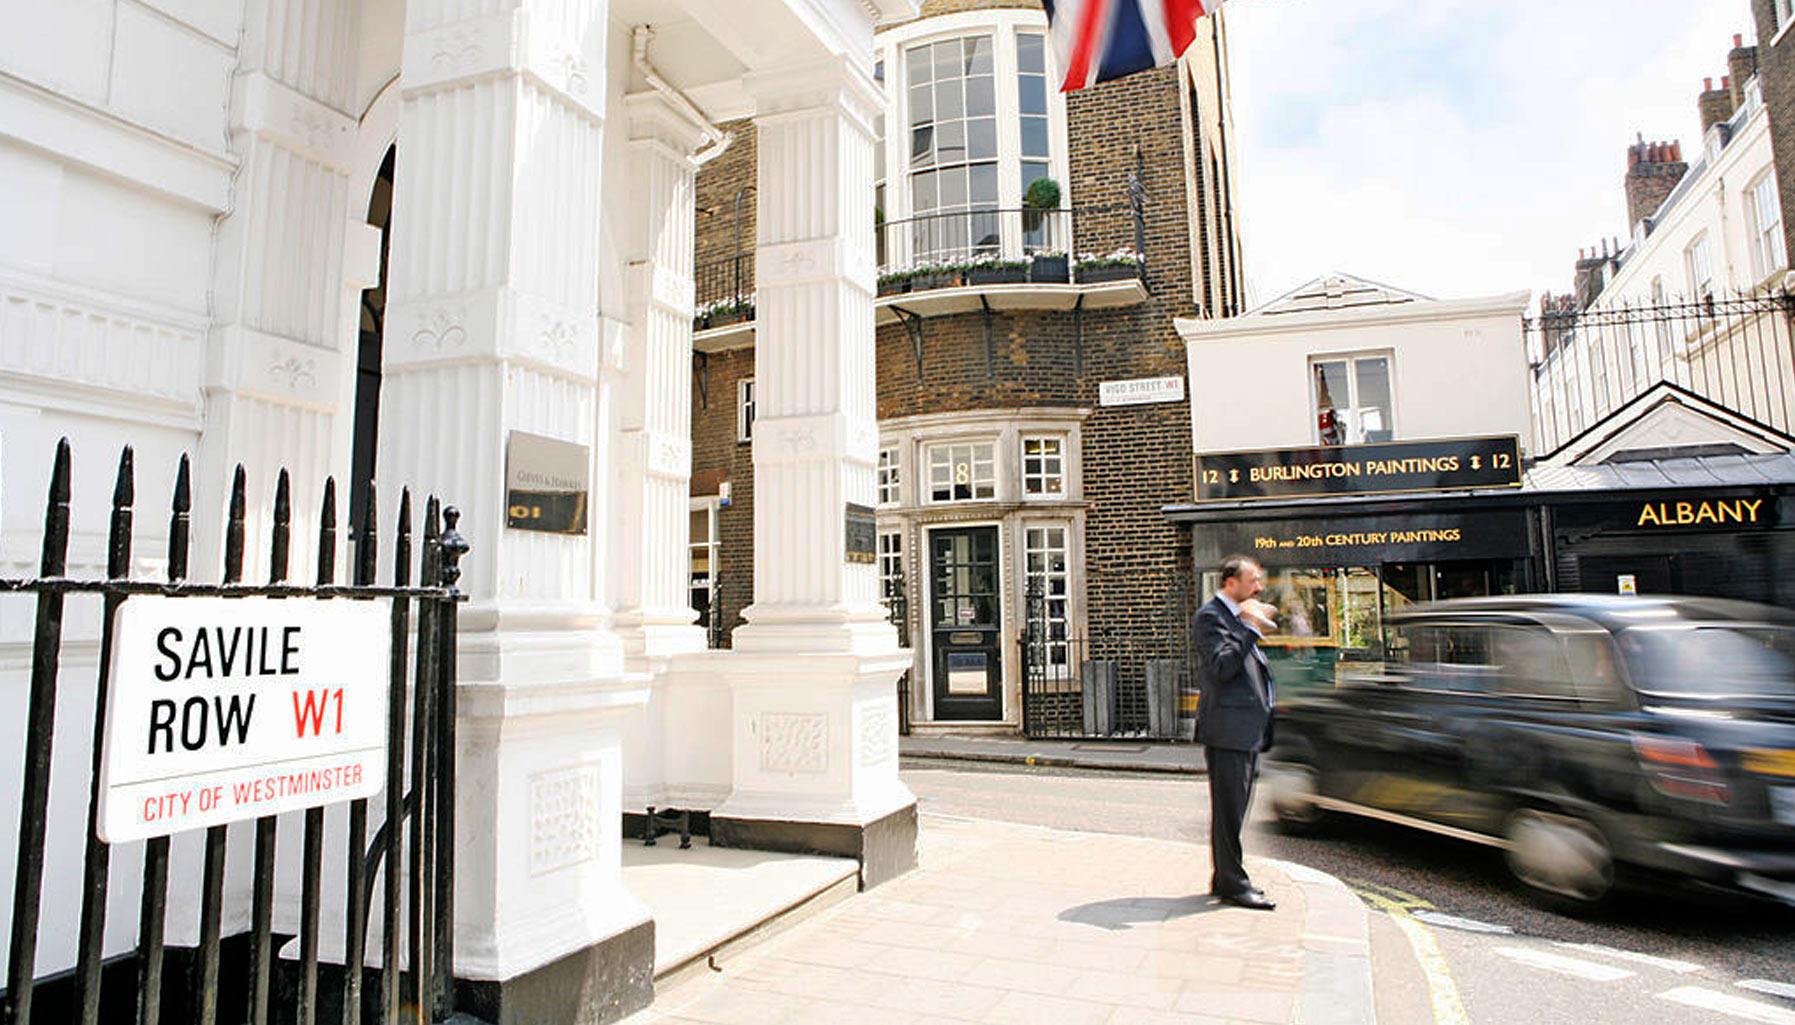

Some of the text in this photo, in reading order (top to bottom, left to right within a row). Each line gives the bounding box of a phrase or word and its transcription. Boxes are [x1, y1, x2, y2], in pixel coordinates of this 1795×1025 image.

[1129, 381, 1161, 393] STREET
[956, 462, 969, 485] 8
[1202, 453, 1511, 484] 12 BURLINGTON PAINTINGS 12
[1637, 499, 1762, 526] ALBANY
[1254, 536, 1277, 549] 19th
[1296, 534, 1324, 548] 20th
[1325, 532, 1389, 546] CENTURY
[1390, 528, 1461, 544] PAINTINGS
[154, 626, 301, 682] SAVILE
[148, 687, 344, 754] ROW W1
[144, 763, 363, 822] CITY OF WESTMINSTER
